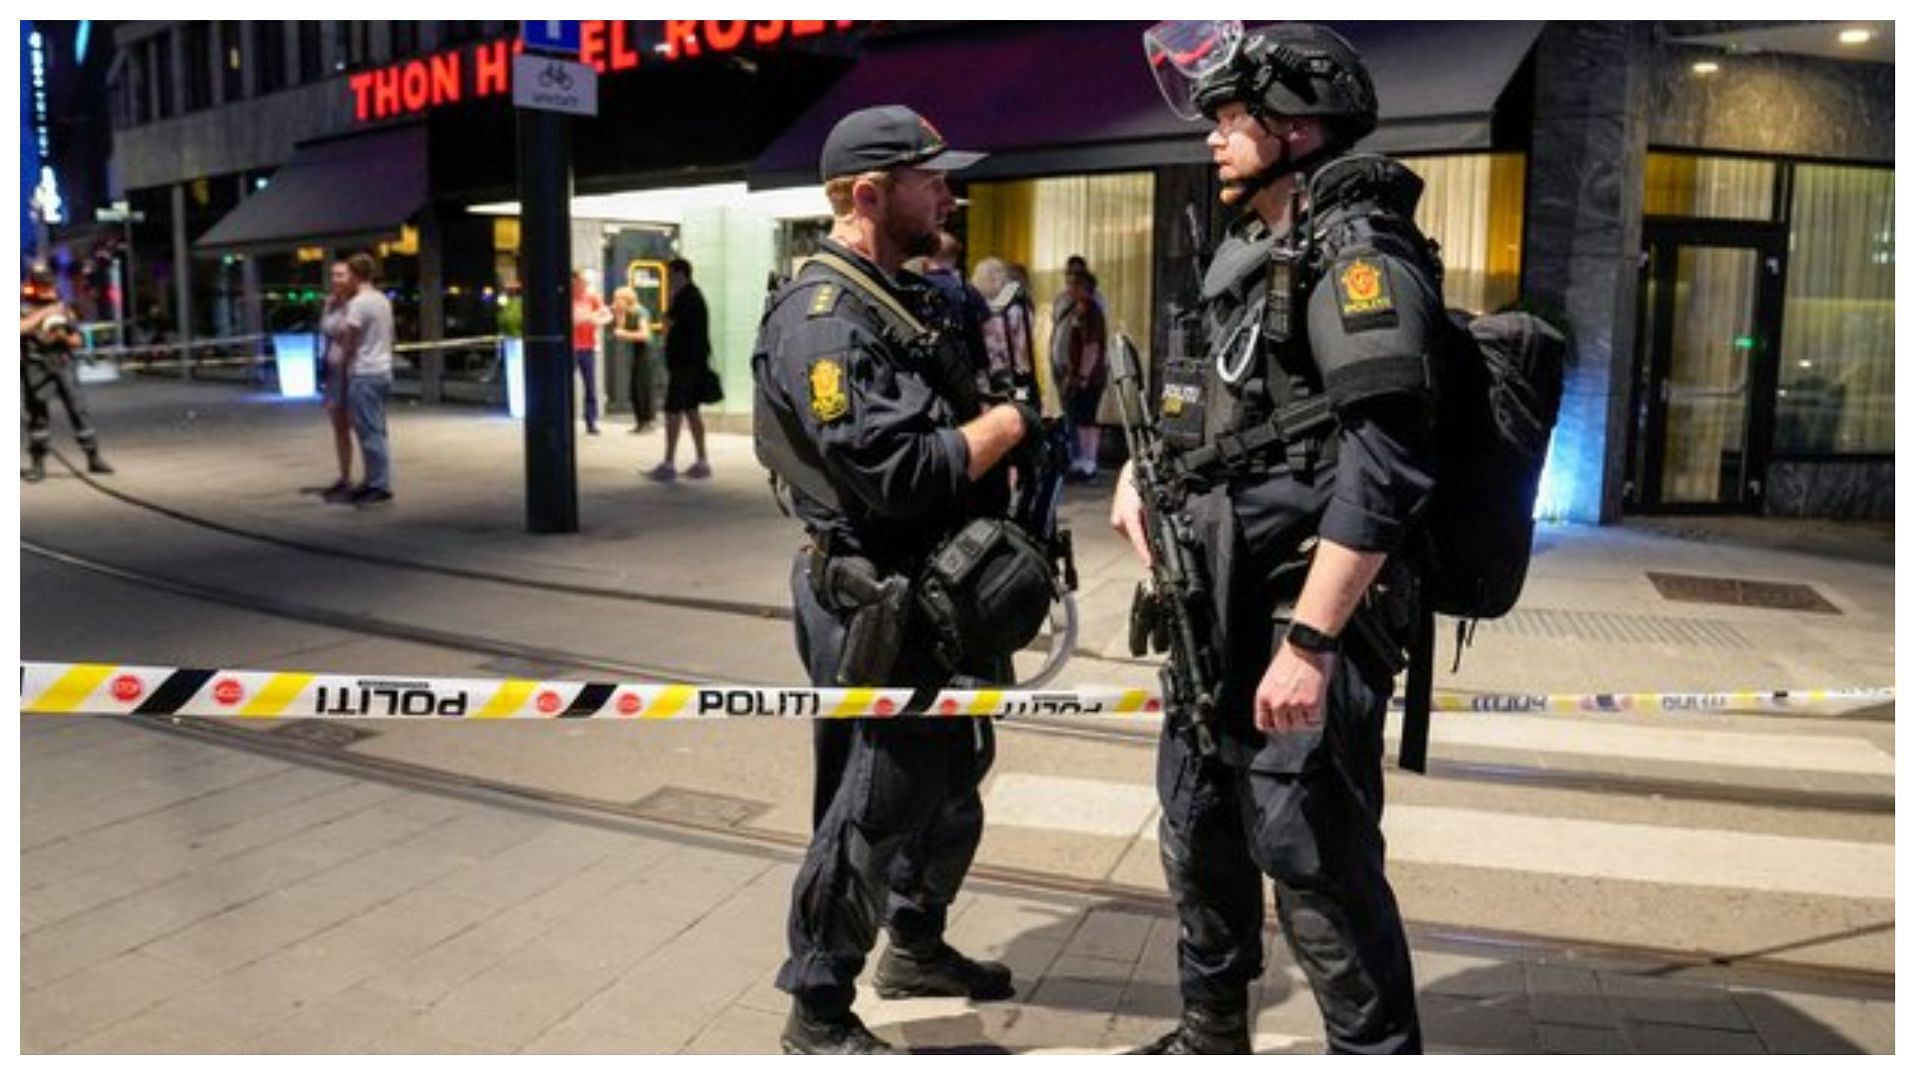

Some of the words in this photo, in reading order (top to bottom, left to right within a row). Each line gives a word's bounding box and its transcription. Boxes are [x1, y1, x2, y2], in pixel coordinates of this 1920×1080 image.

[350, 52, 461, 120] THON
[473, 20, 639, 96] HEL
[315, 686, 468, 716] POLITI
[698, 690, 821, 716] POLITI
